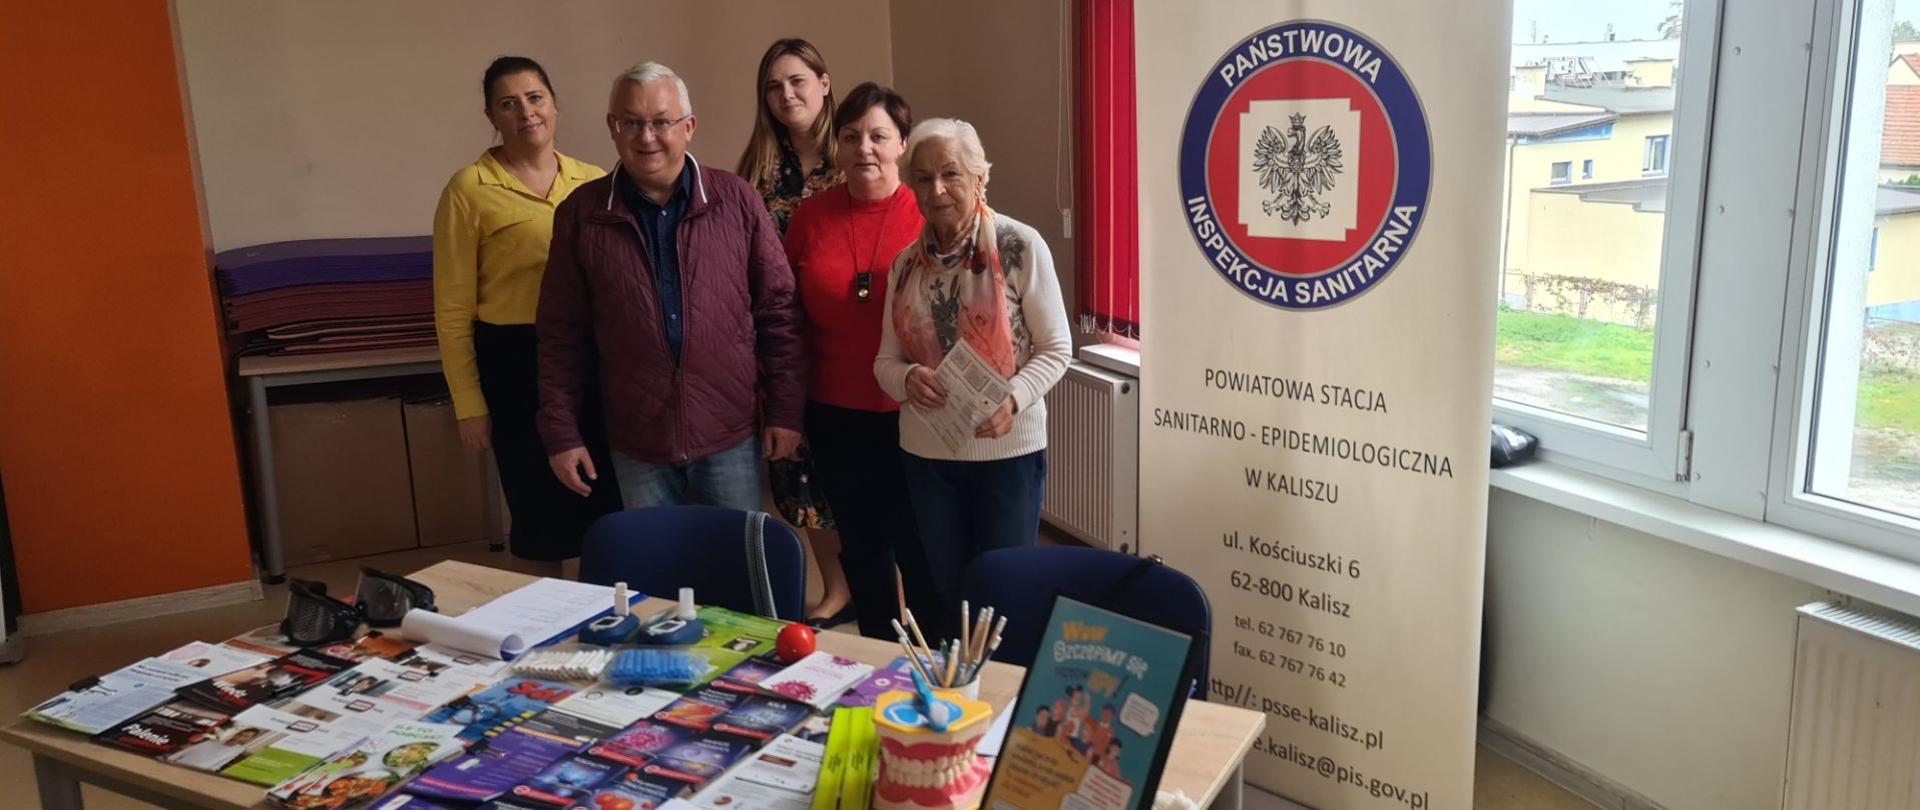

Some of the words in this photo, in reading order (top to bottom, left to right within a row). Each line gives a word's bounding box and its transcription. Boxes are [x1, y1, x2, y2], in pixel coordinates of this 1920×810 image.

[1220, 29, 1382, 87] PAŃSTWOWA
[1187, 196, 1289, 303] INSPEKCJA
[1295, 204, 1417, 304] SANITARNA
[1205, 368, 1315, 402] POWIATOWA
[1320, 384, 1387, 413] STACJA
[1154, 408, 1246, 440] SANITARNO
[1262, 426, 1453, 479] EPIDEMIOLOGICZNA
[1245, 467, 1262, 488] W
[1267, 472, 1339, 504] KALISZU
[1223, 531, 1243, 550] ul.
[1250, 535, 1342, 575] Kościuszki
[1348, 560, 1360, 579] 6
[1230, 570, 1293, 602] 62-800
[1299, 588, 1351, 618] Kalisz
[1234, 615, 1255, 632] tel.
[1258, 621, 1275, 637] 62
[1278, 626, 1303, 645] 767
[1308, 636, 1325, 652] 76
[1329, 642, 1346, 658] 10
[1233, 641, 1256, 660] fax.
[1259, 650, 1276, 666] 62
[1279, 656, 1304, 675] 767
[1309, 665, 1325, 681] 76
[1329, 671, 1347, 688] 42
[1209, 677, 1257, 708] ttp//:
[1262, 699, 1384, 750] psse-kalisz.pl
[1252, 735, 1429, 810] e.kalisz@pis.gov.pl
